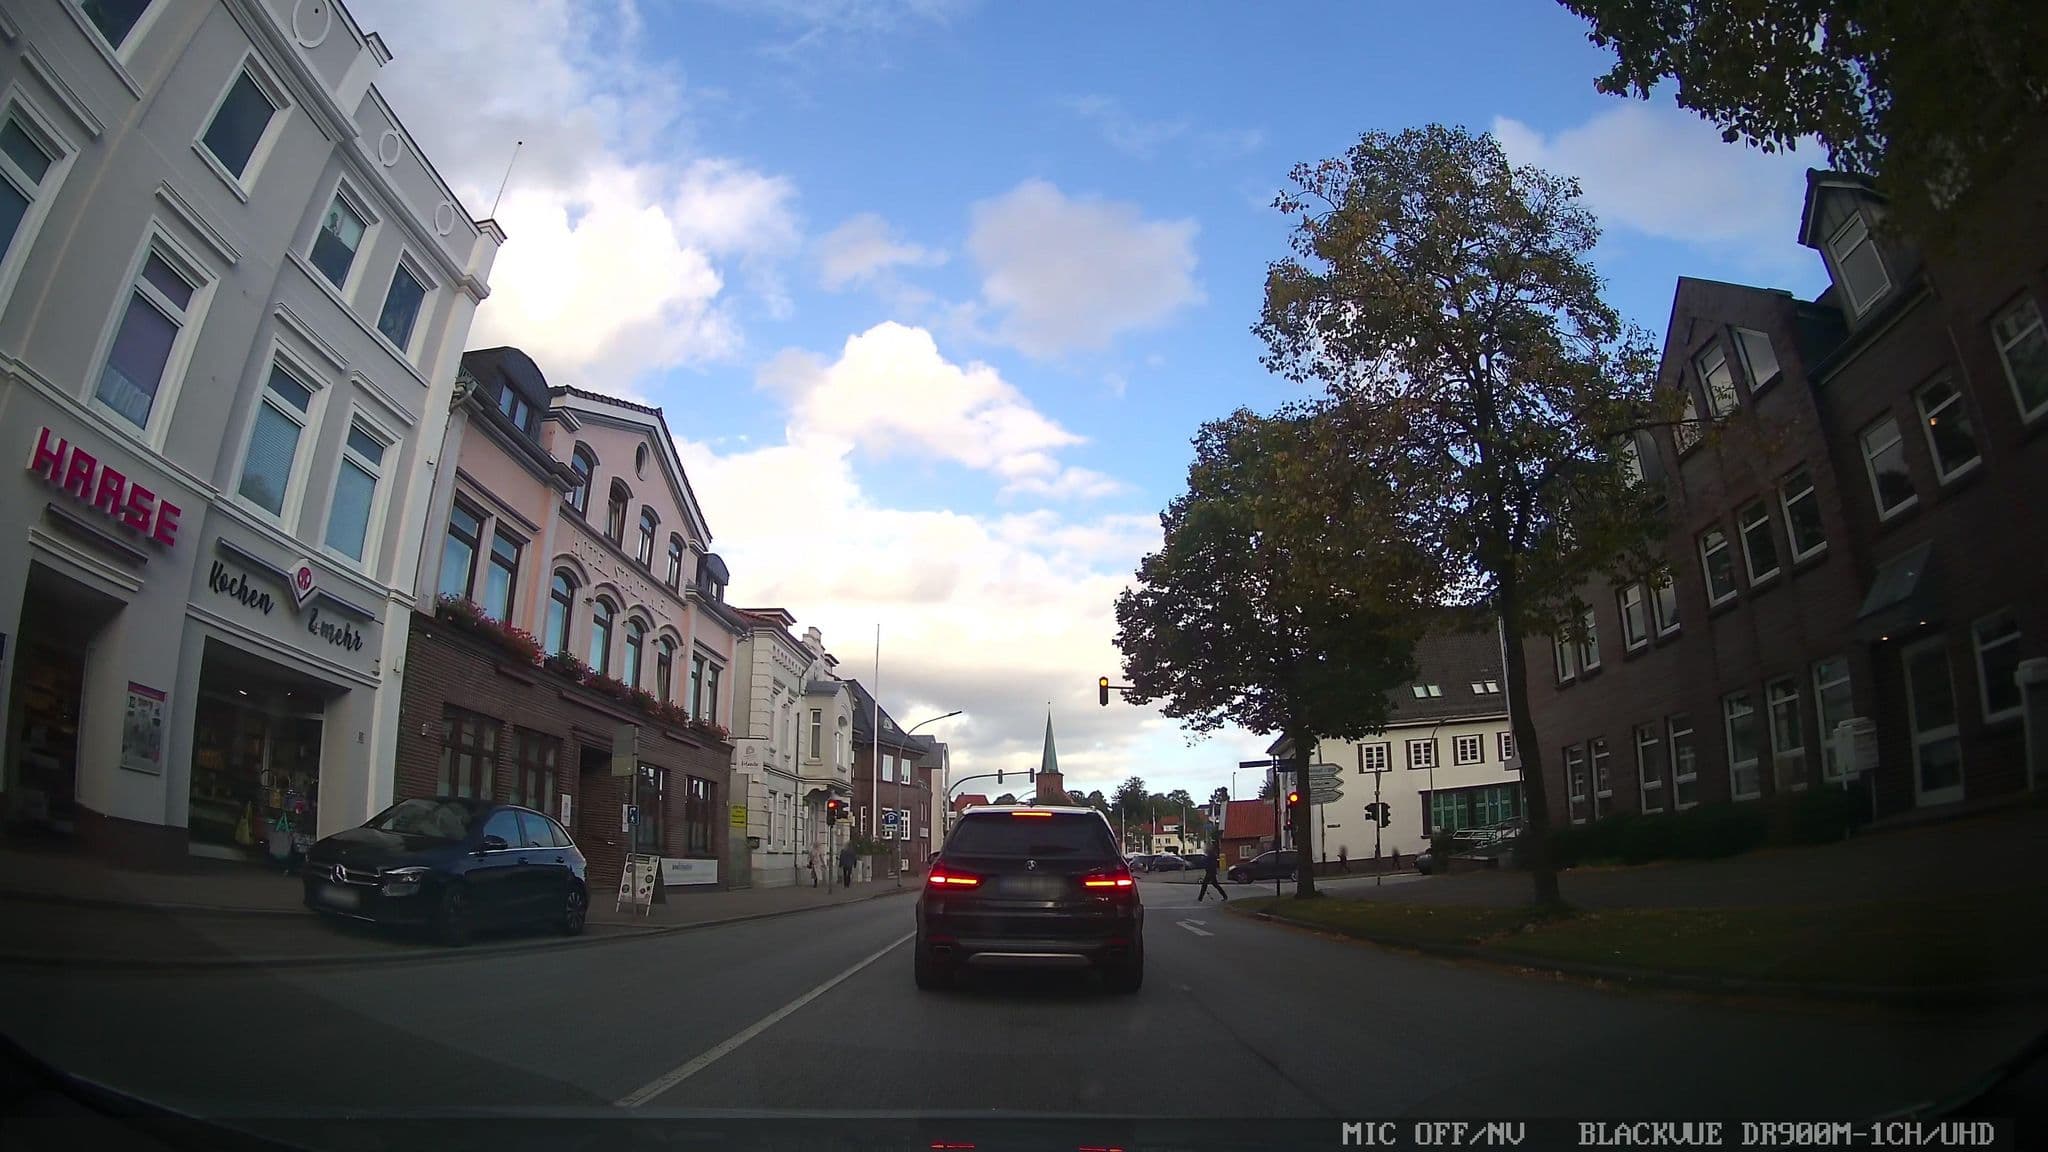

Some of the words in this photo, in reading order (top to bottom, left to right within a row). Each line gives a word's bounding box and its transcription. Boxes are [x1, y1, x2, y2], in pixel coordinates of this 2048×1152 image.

[30, 426, 181, 547] HAASE
[208, 559, 275, 616] Kochen
[319, 619, 363, 652] mehr
